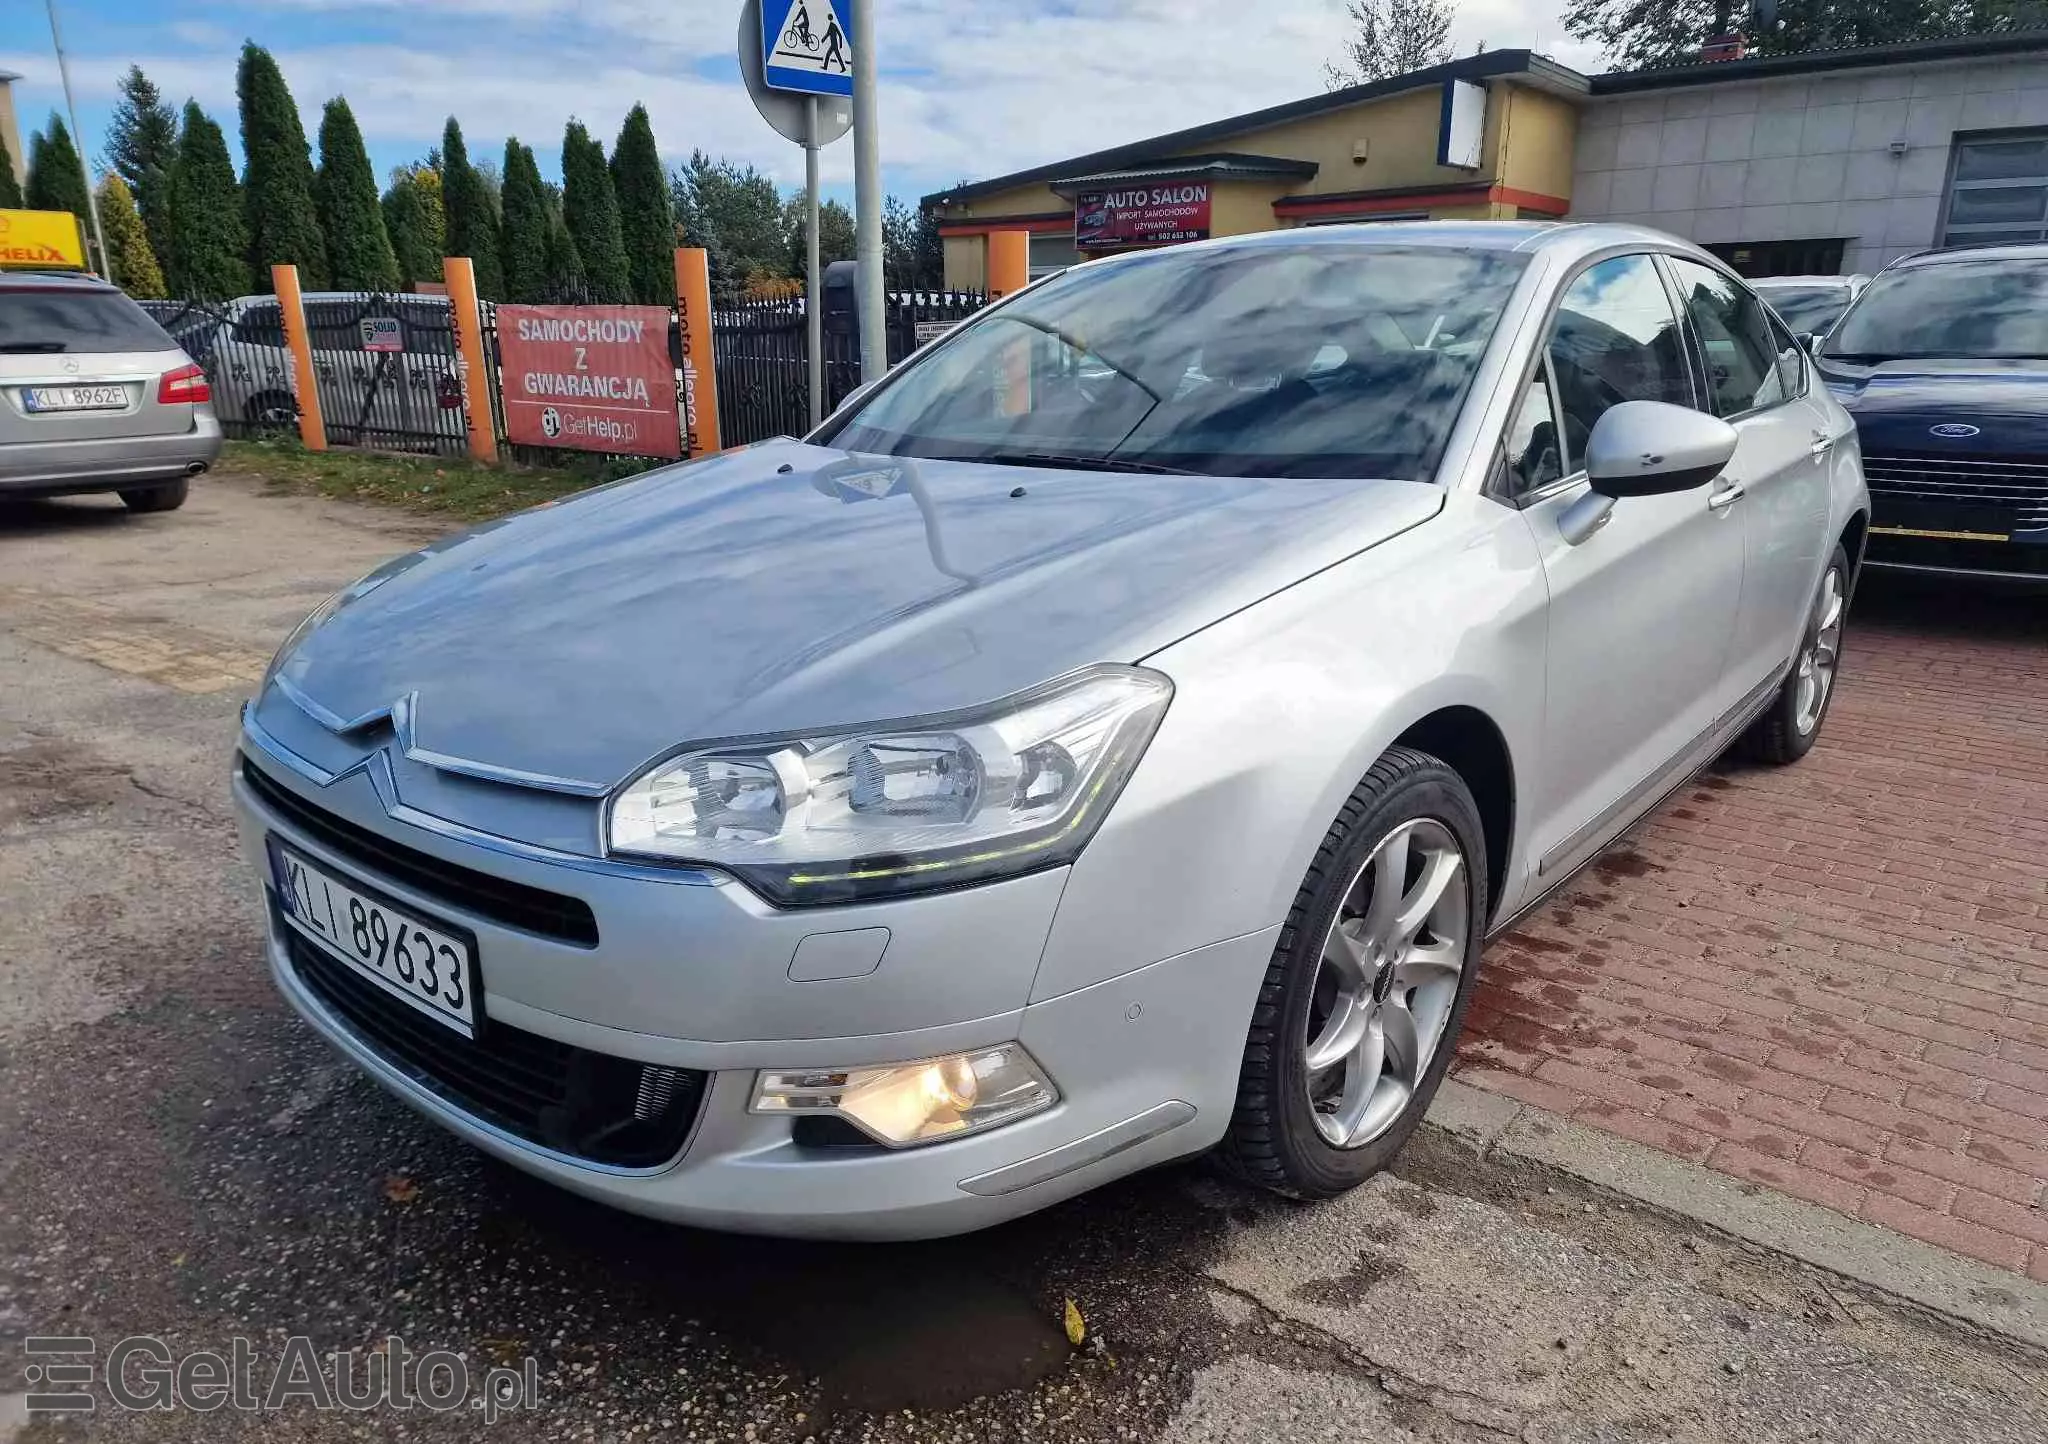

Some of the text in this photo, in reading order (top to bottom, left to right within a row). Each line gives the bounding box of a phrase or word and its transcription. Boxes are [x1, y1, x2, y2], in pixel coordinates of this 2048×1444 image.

[1104, 189, 1148, 209] AUTO
[1152, 184, 1207, 206] SALON
[1116, 210, 1141, 220] IMPORT
[1185, 230, 1198, 239] 106
[517, 318, 645, 344] SAMOCHODY
[575, 347, 588, 370] Z
[33, 388, 121, 408] KLI 8962F
[524, 372, 651, 408] GWARANCJĄ
[563, 413, 637, 443] GetHelp.pl
[283, 855, 464, 1010] KLI 89633
